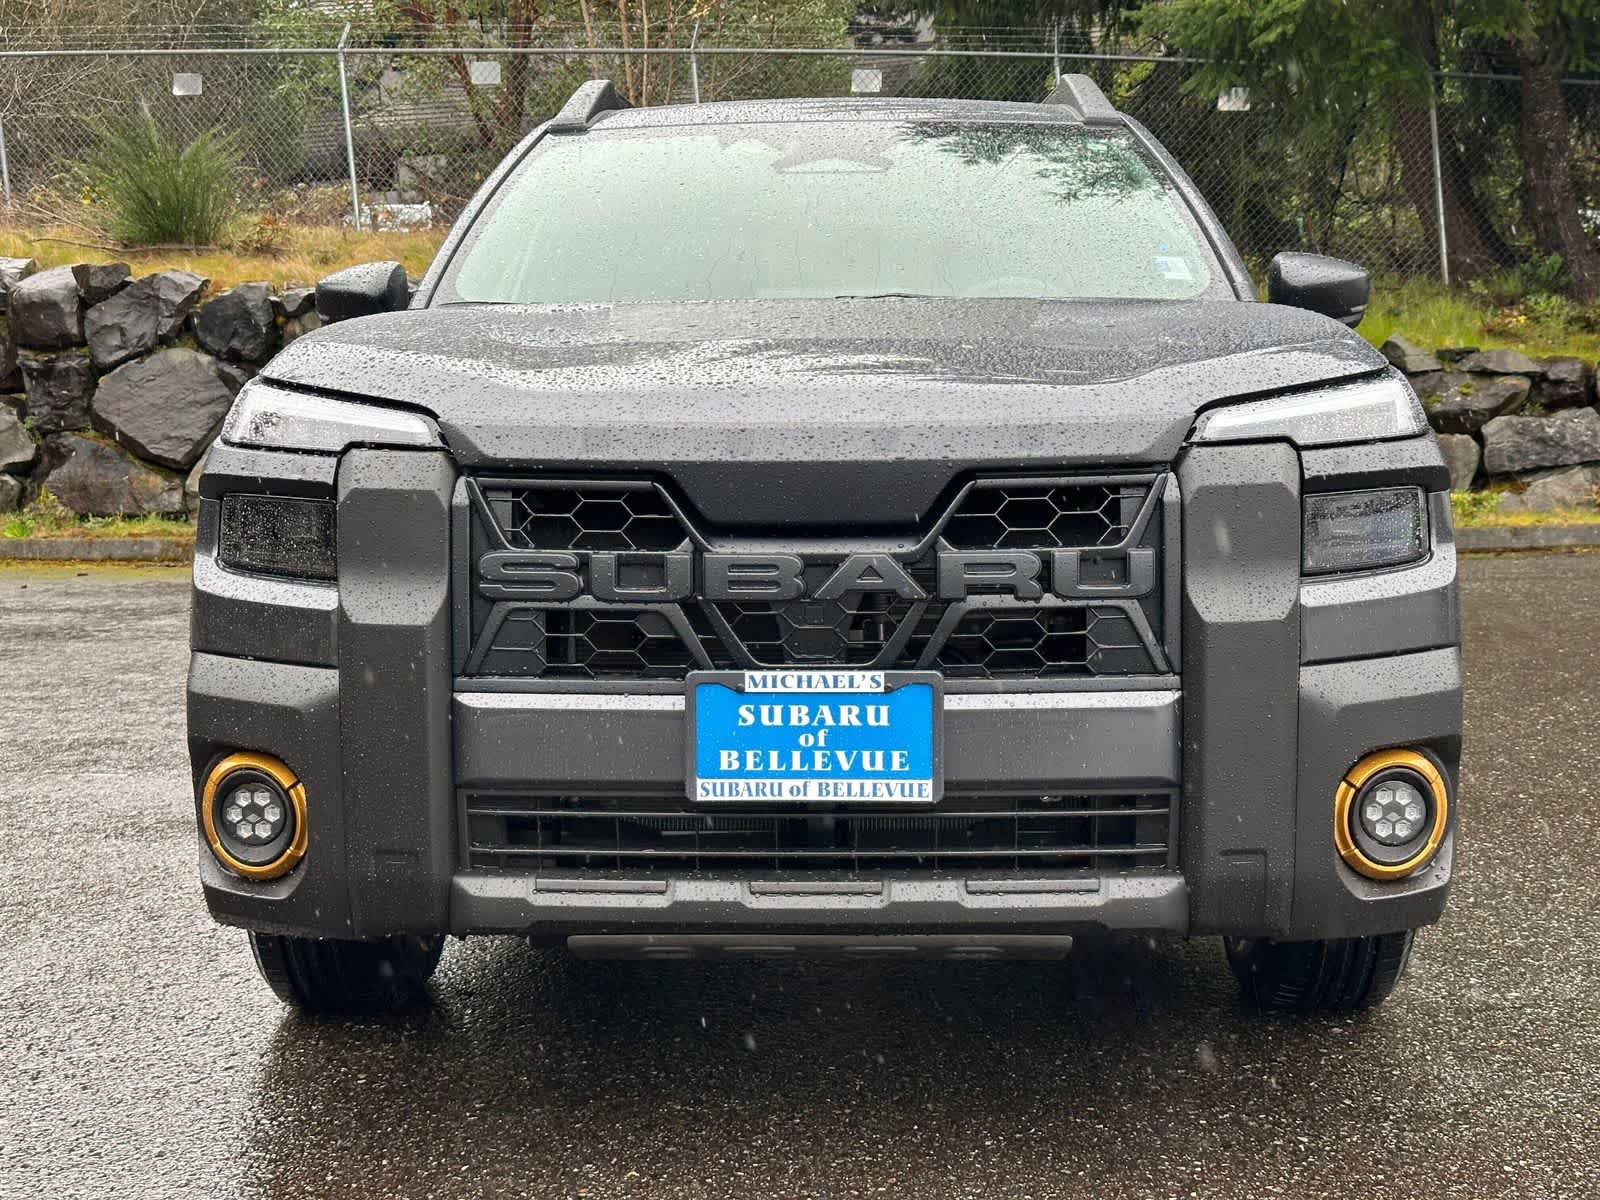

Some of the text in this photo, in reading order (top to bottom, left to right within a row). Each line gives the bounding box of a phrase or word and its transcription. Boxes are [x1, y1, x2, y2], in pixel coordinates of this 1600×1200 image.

[479, 549, 1156, 601] SUBARU
[747, 674, 882, 689] MICHAEL'S
[738, 704, 890, 726] SUBARU
[798, 729, 829, 748] of
[719, 750, 910, 772] BELLEVUE
[700, 780, 930, 799] SUBARU of BELLEVUE
